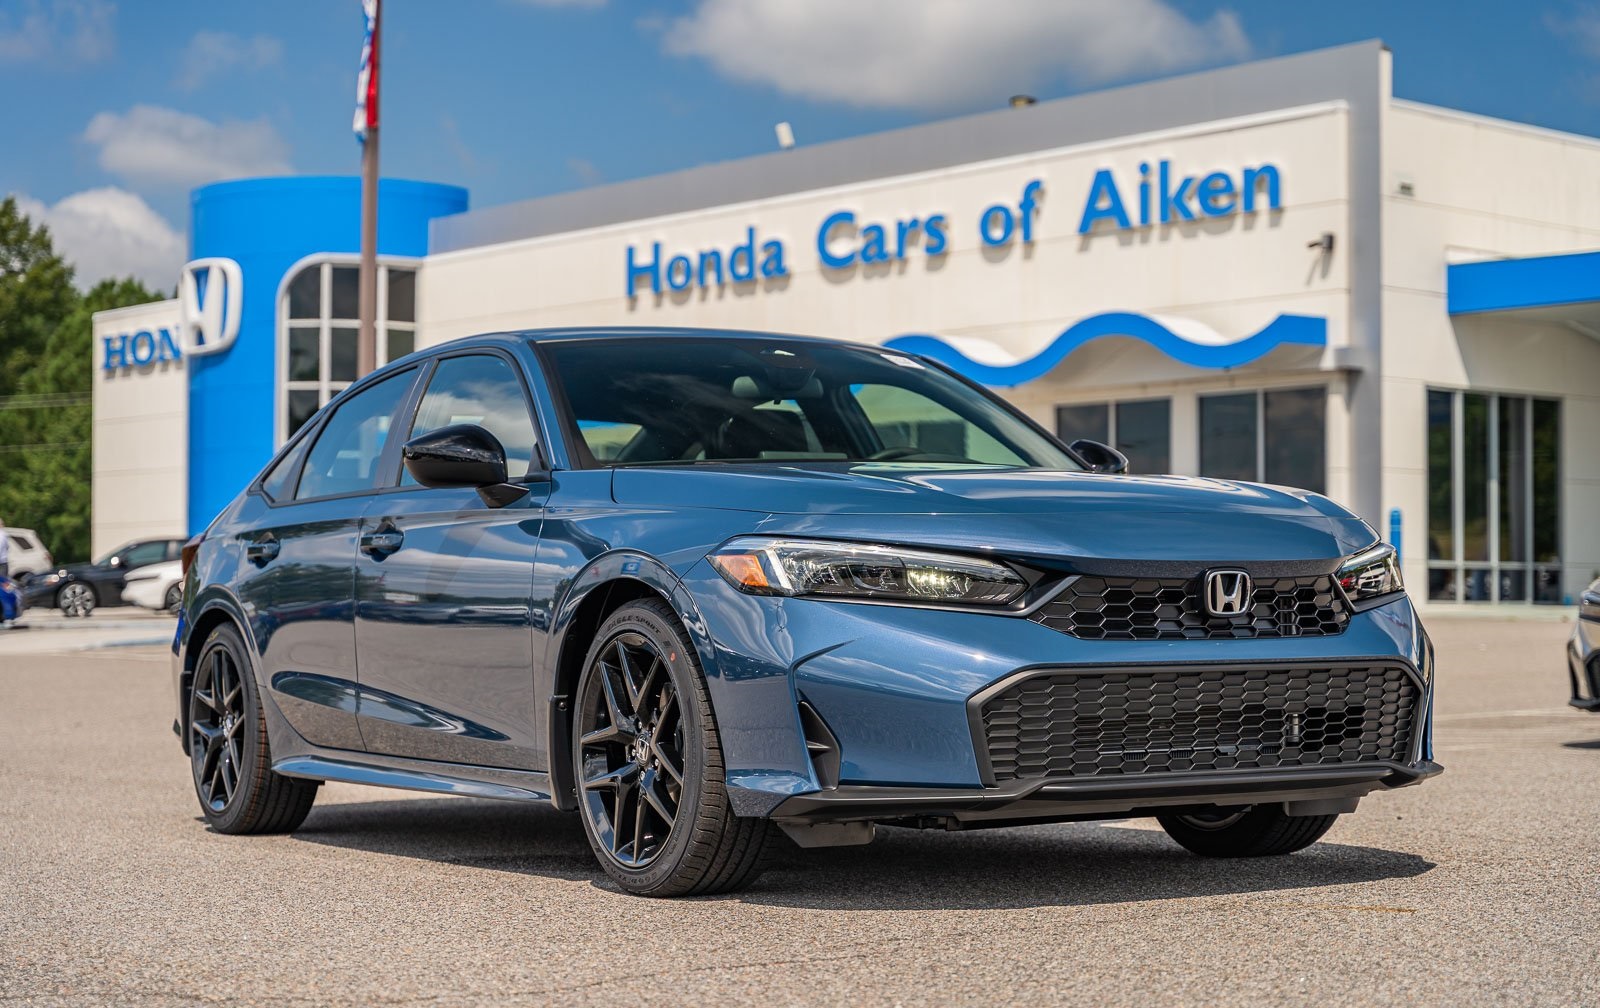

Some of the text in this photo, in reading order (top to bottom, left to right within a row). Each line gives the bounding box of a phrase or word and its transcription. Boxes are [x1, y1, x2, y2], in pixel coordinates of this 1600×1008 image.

[627, 160, 1282, 297] Honda Cars of Aiken
[103, 328, 181, 370] HON
[634, 615, 661, 634] SPORT
